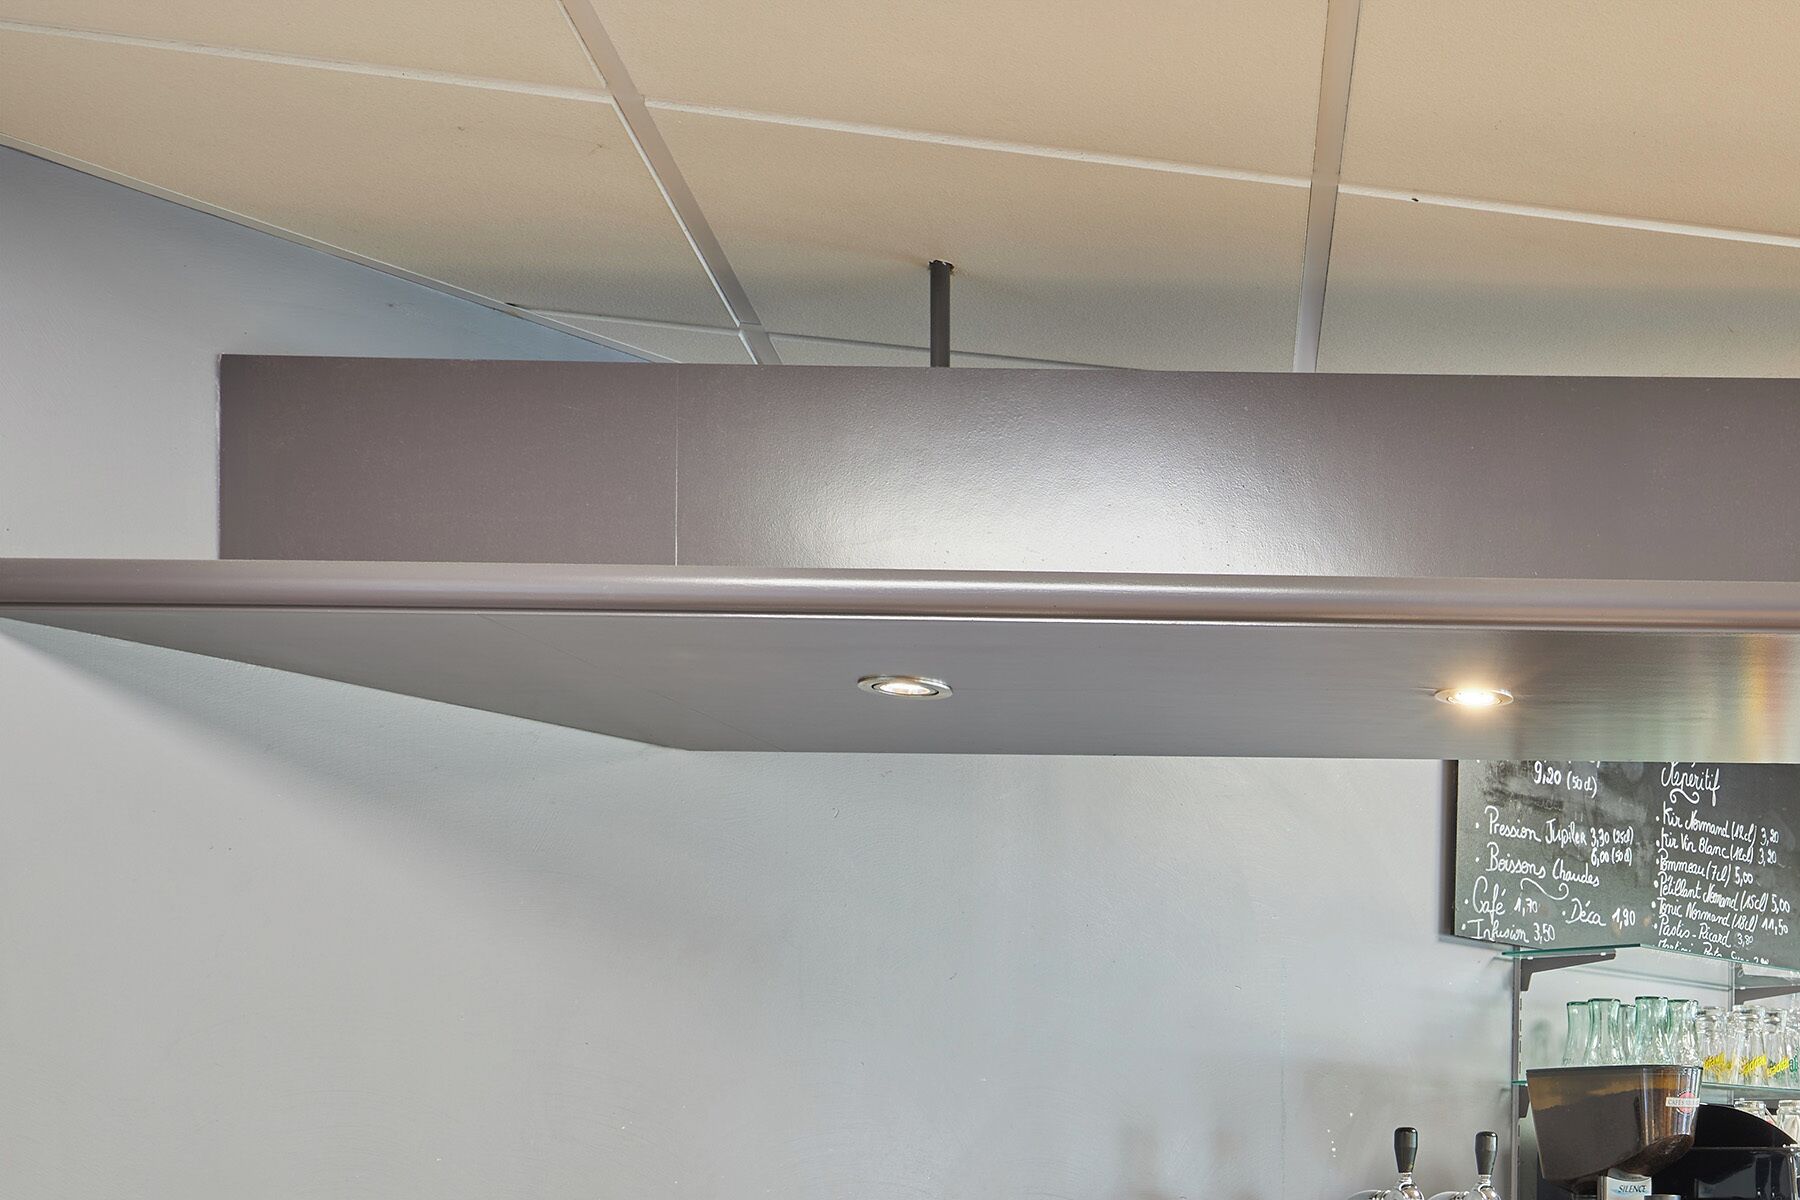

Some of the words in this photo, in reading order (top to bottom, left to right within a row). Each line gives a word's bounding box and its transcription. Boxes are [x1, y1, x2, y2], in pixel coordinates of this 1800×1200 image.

[1534, 761, 1562, 785] 9,20
[1484, 805, 1542, 843] Pression
[1663, 801, 1683, 828] Kir
[1685, 810, 1731, 838] Normand
[1660, 827, 1679, 849] Kir
[1681, 833, 1697, 853] Vin
[1699, 837, 1730, 859] Blanc
[1486, 841, 1546, 879] Boissons
[1552, 858, 1601, 888] Chaudes
[1734, 866, 1754, 887] 5,00
[1472, 876, 1507, 925] Café
[1513, 897, 1539, 918] 1,70
[1565, 897, 1607, 927] Déca
[1771, 894, 1791, 915] 5,00
[1467, 919, 1530, 943] Infusion
[1533, 922, 1556, 945] 3,50
[1658, 914, 1691, 938] Pastis
[1698, 922, 1732, 948] Ricard
[1685, 902, 1731, 928] Normand
[1761, 918, 1789, 936] 11,50
[1618, 1184, 1647, 1193] SILENCE
